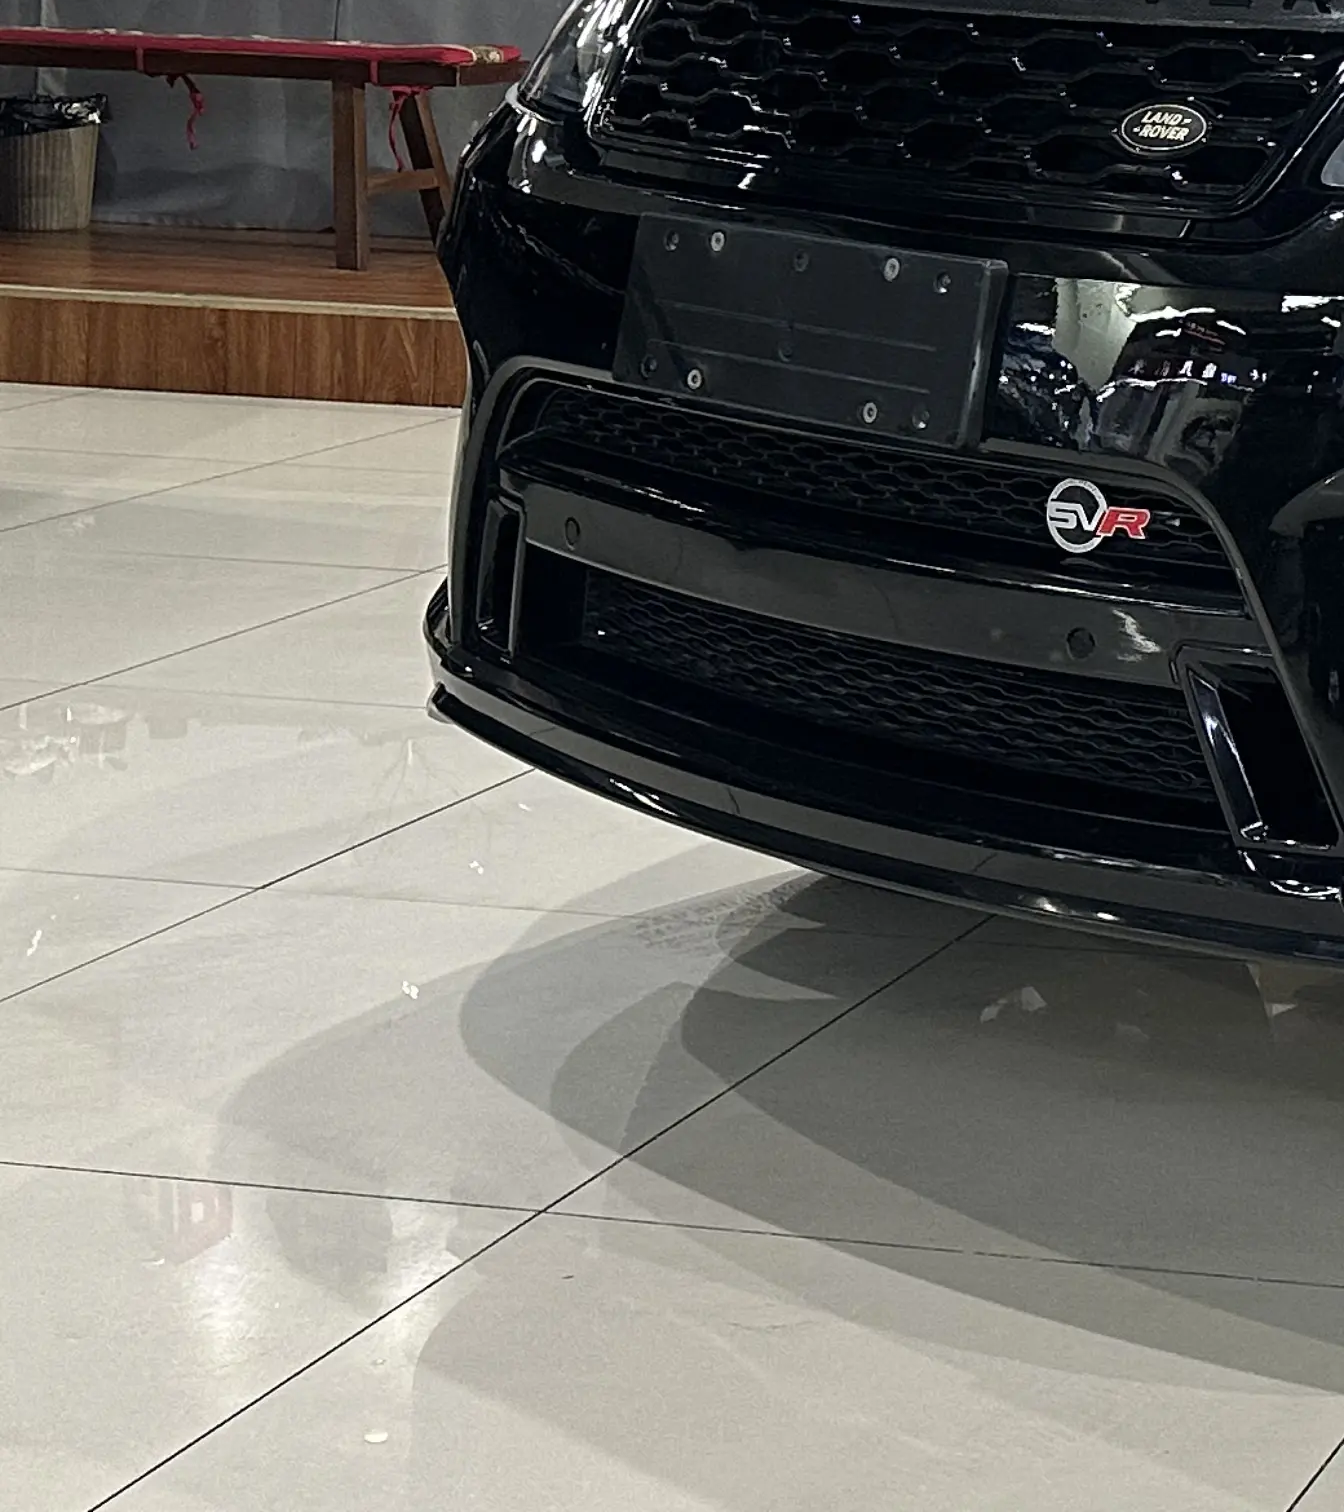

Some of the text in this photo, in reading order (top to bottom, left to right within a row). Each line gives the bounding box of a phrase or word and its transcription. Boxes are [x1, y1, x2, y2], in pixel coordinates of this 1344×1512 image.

[1141, 110, 1183, 125] LAND
[1138, 124, 1190, 141] ROVER
[1048, 499, 1151, 539] SVR
